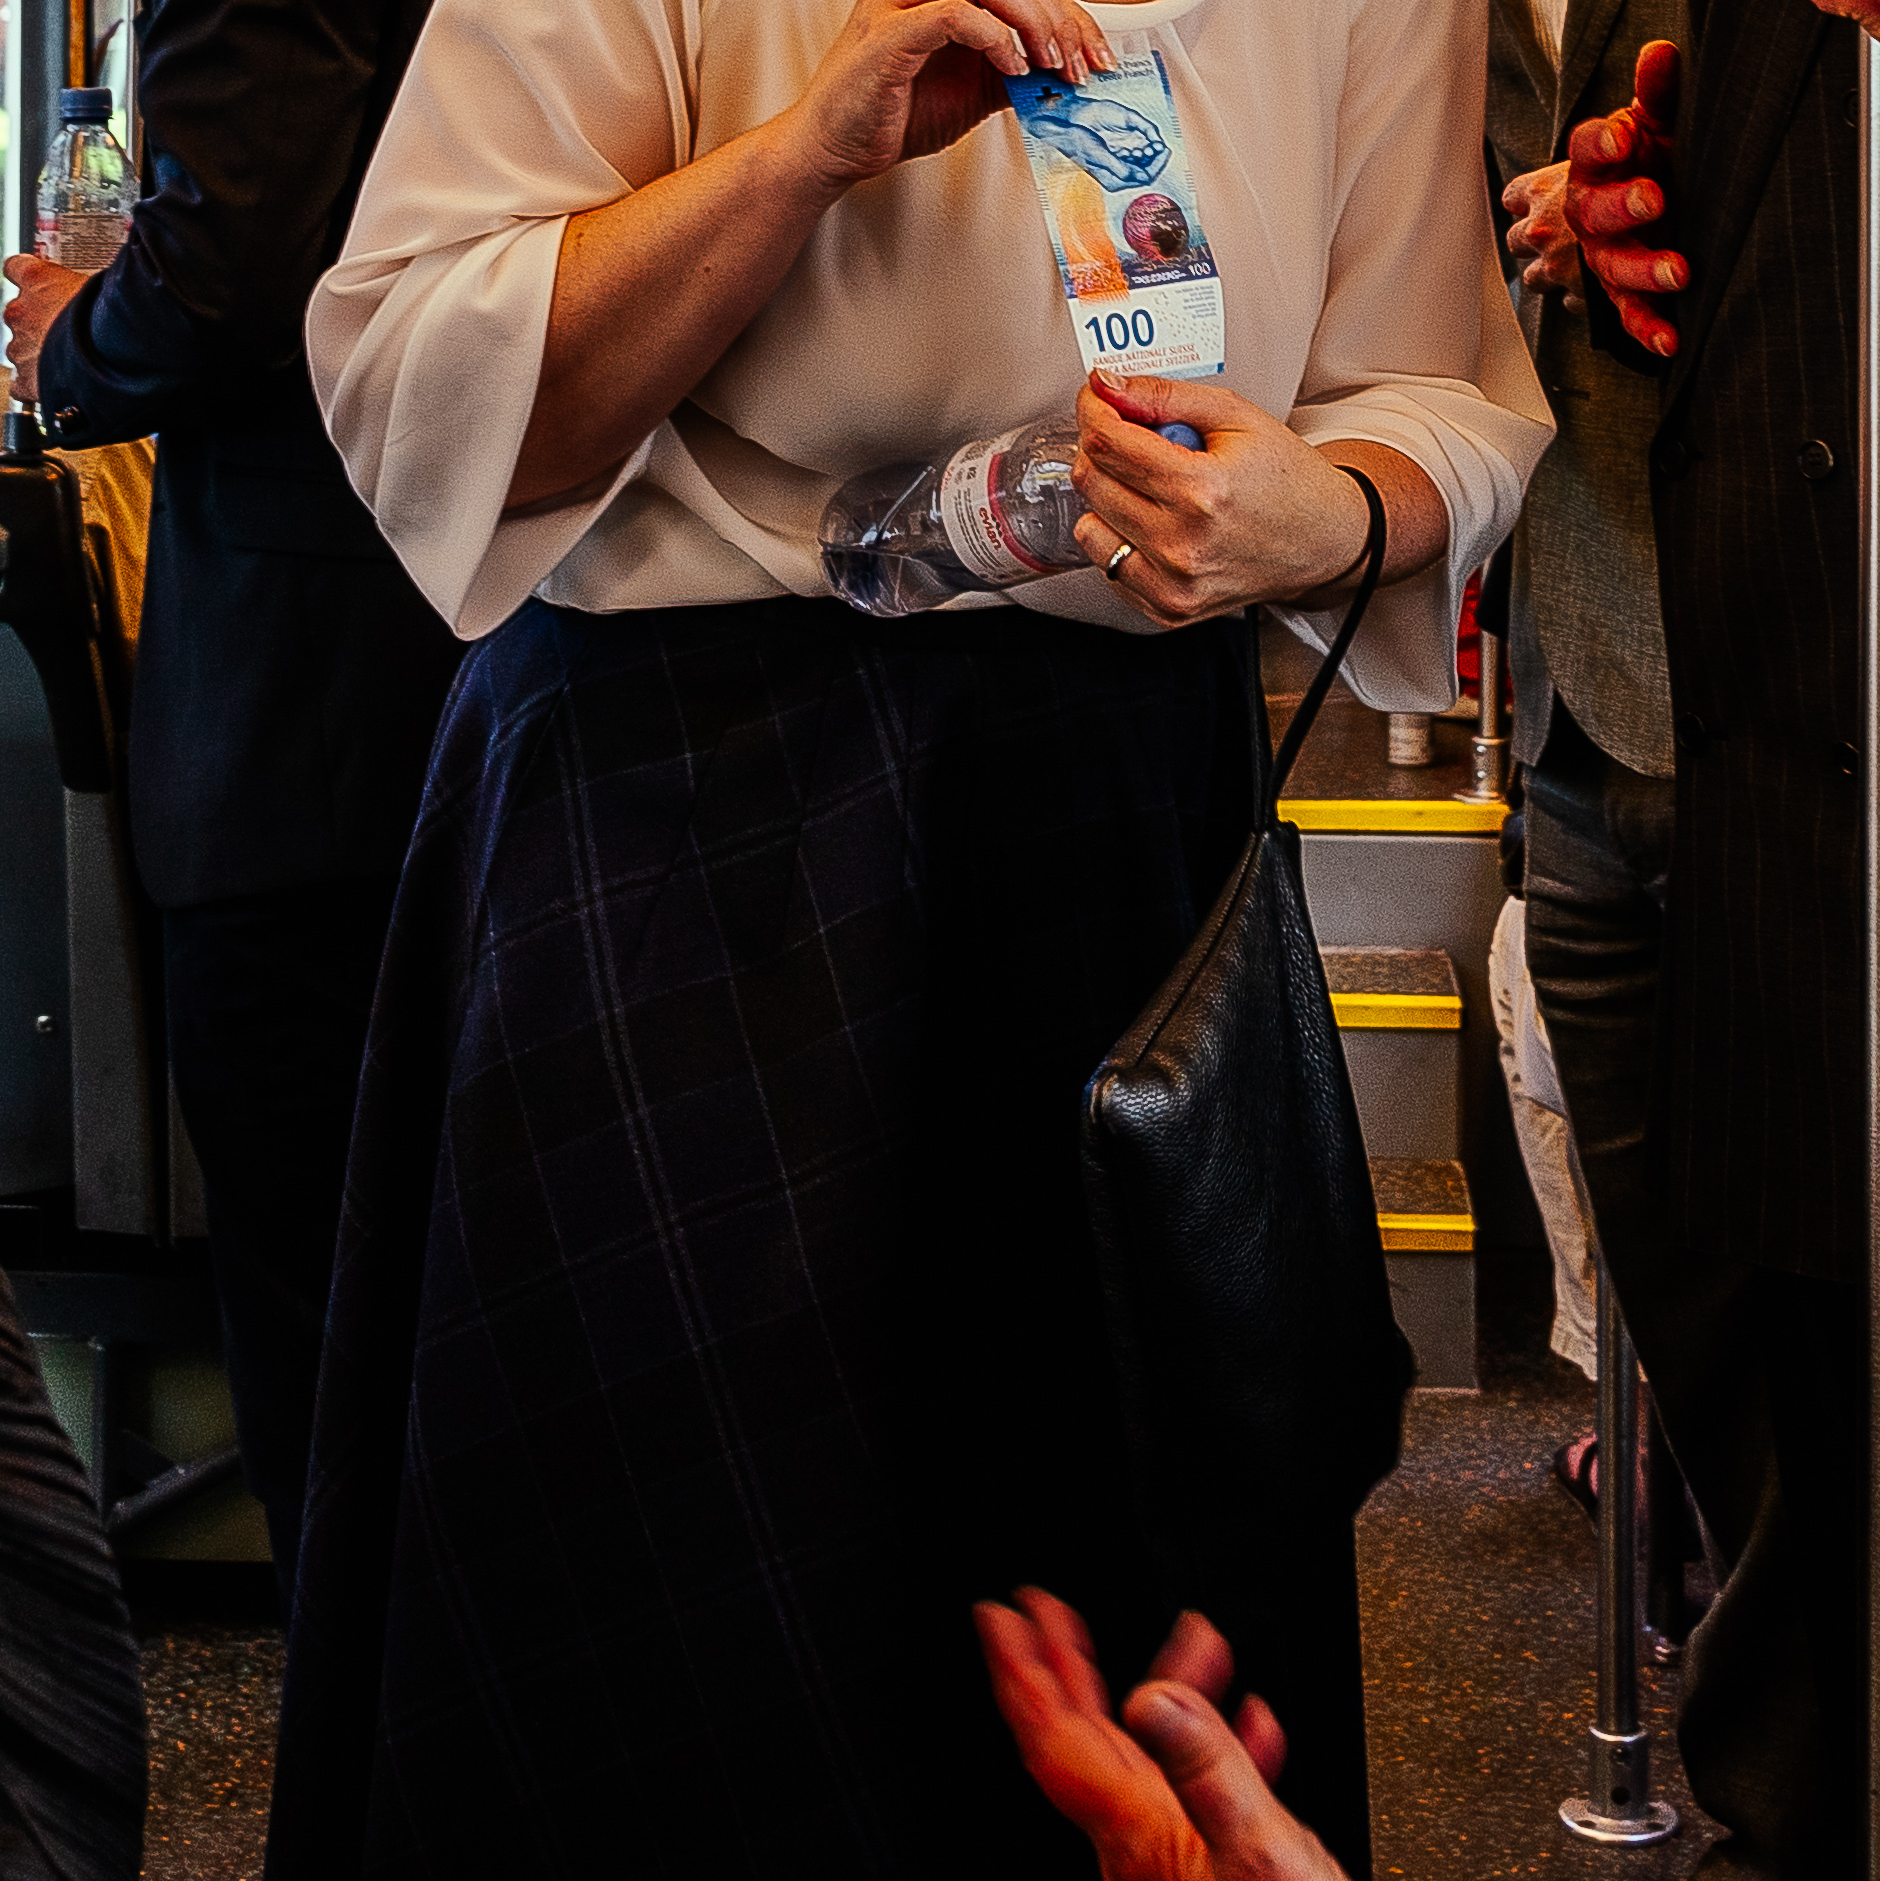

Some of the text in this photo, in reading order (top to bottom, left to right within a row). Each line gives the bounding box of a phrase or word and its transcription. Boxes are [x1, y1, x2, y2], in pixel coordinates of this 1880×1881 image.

[1187, 261, 1212, 276] 100
[1085, 308, 1155, 353] 100
[1093, 343, 1196, 367] BANQUE NATIONALE SUISSE
[1120, 358, 1164, 374] NAZIONALE
[1165, 352, 1201, 367] SVIZZERA
[979, 507, 1002, 551] evian
